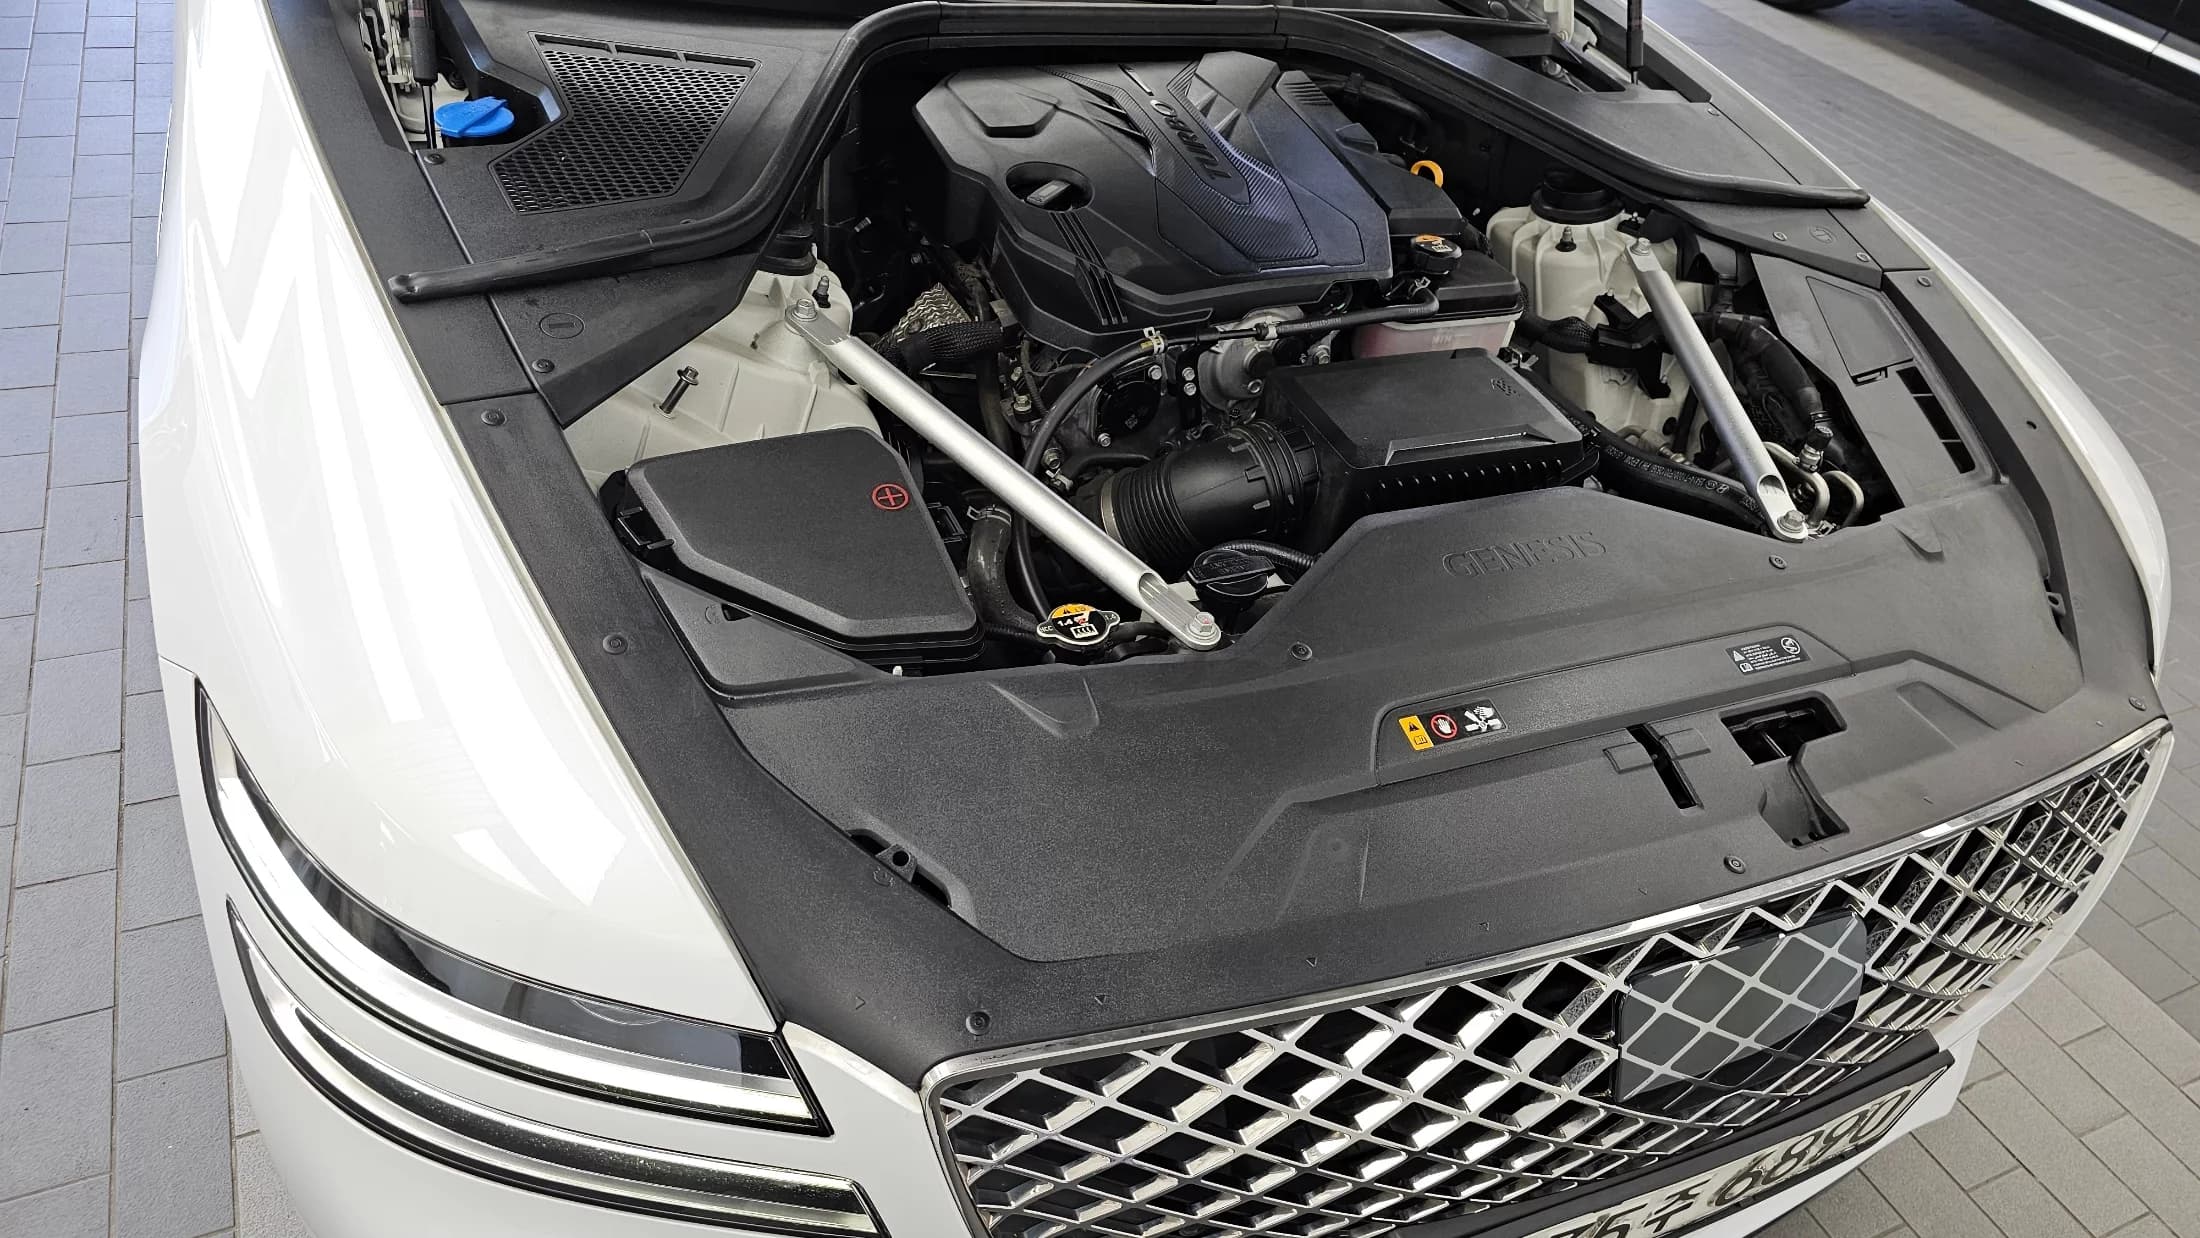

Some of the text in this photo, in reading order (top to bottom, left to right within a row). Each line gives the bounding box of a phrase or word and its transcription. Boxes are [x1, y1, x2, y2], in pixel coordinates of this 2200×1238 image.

[1149, 99, 1233, 180] TURBO
[1441, 530, 1608, 578] GENESIS
[1714, 1089, 1912, 1208] 6890
